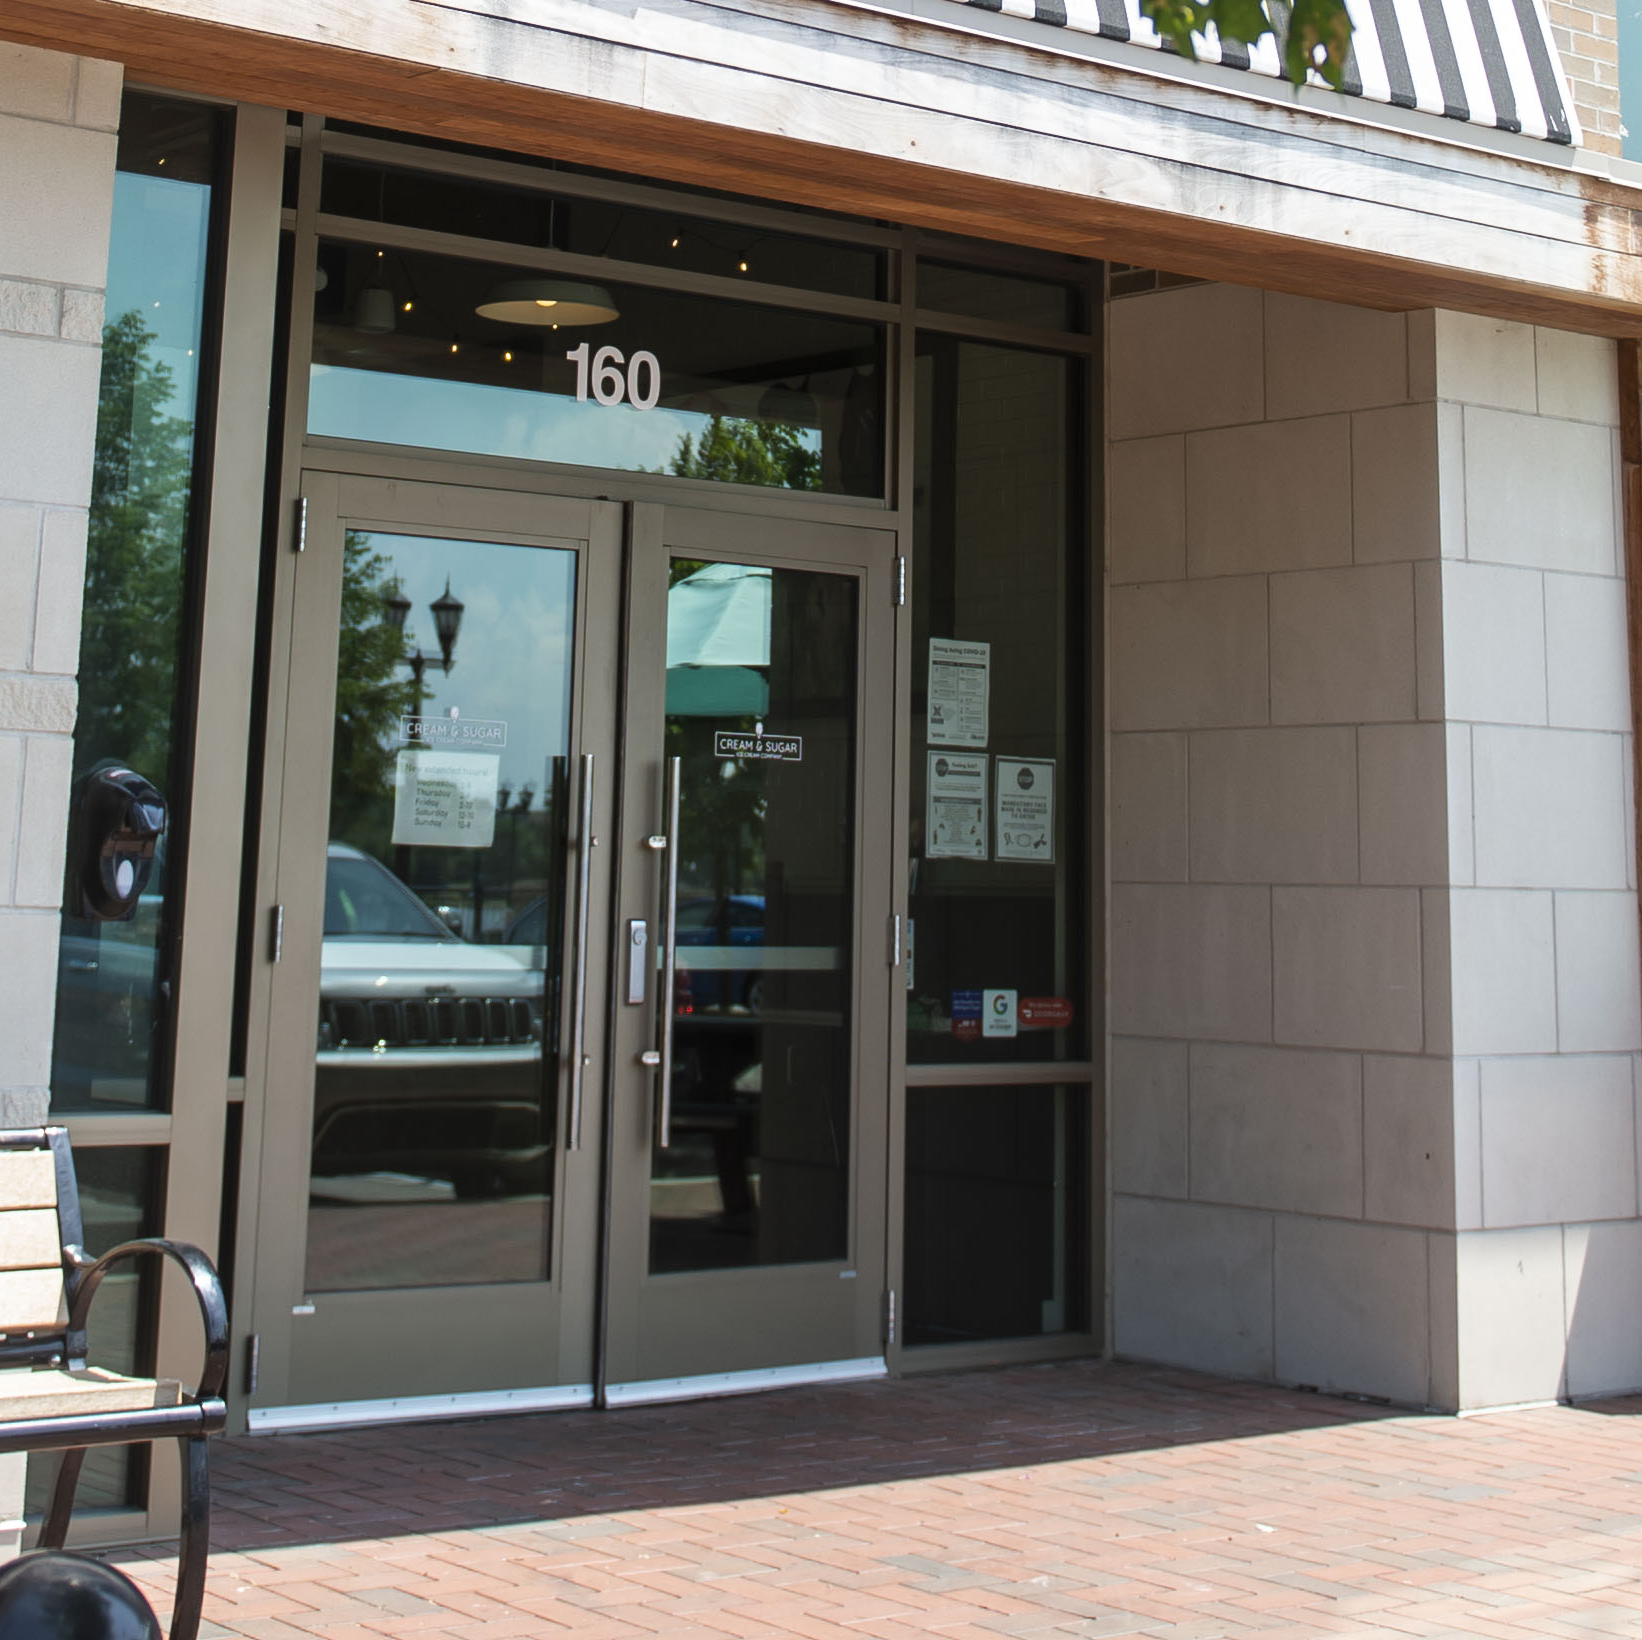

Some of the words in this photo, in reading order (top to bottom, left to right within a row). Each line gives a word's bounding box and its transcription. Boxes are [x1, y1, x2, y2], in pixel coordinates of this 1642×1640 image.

[566, 342, 661, 410] 160
[406, 723, 447, 736] CREAM
[450, 725, 458, 737] &
[462, 726, 501, 739] SUGAR
[720, 738, 753, 751] CREAM
[755, 741, 763, 752] &
[766, 741, 798, 753] SUGAR
[415, 798, 440, 808] Friday
[414, 808, 449, 818] Saturday
[413, 817, 443, 828] Sunday
